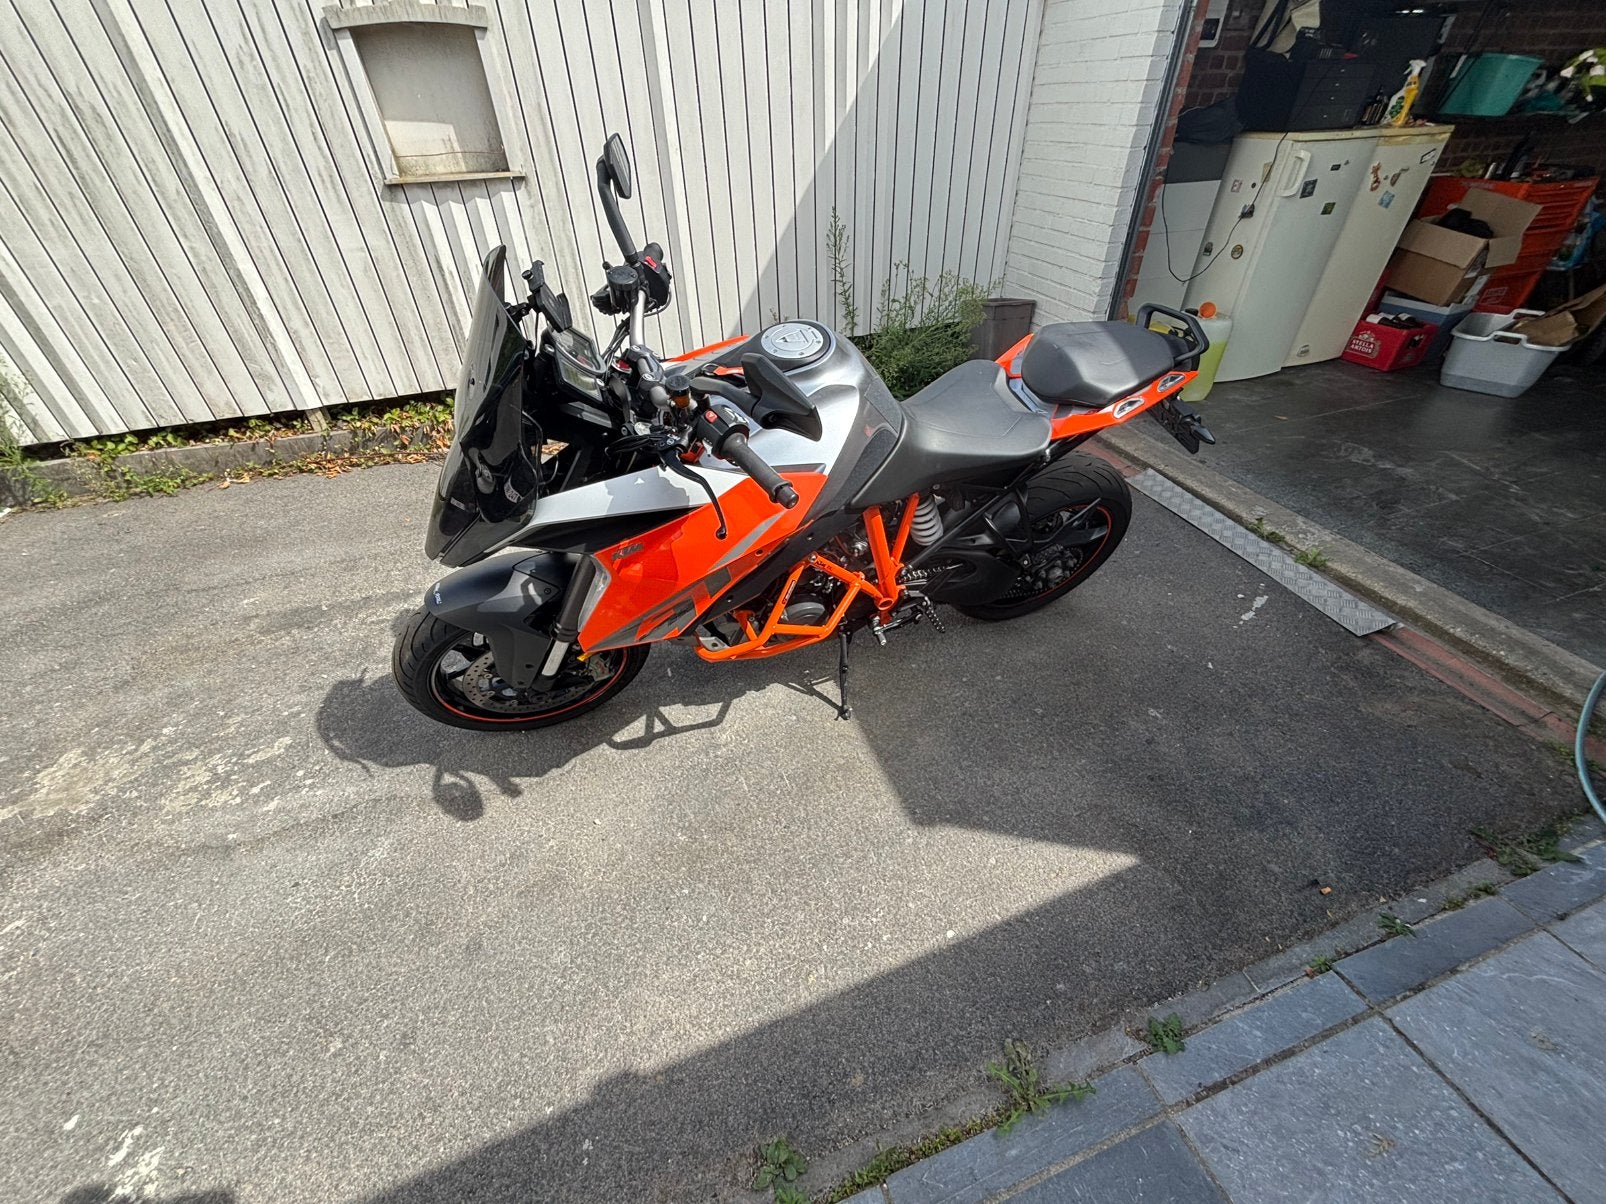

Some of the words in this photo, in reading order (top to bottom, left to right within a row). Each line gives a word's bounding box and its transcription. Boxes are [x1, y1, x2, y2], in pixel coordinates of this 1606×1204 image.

[1350, 344, 1372, 354] ARTOIS
[1352, 339, 1374, 349] STELLA
[612, 543, 643, 560] KTM
